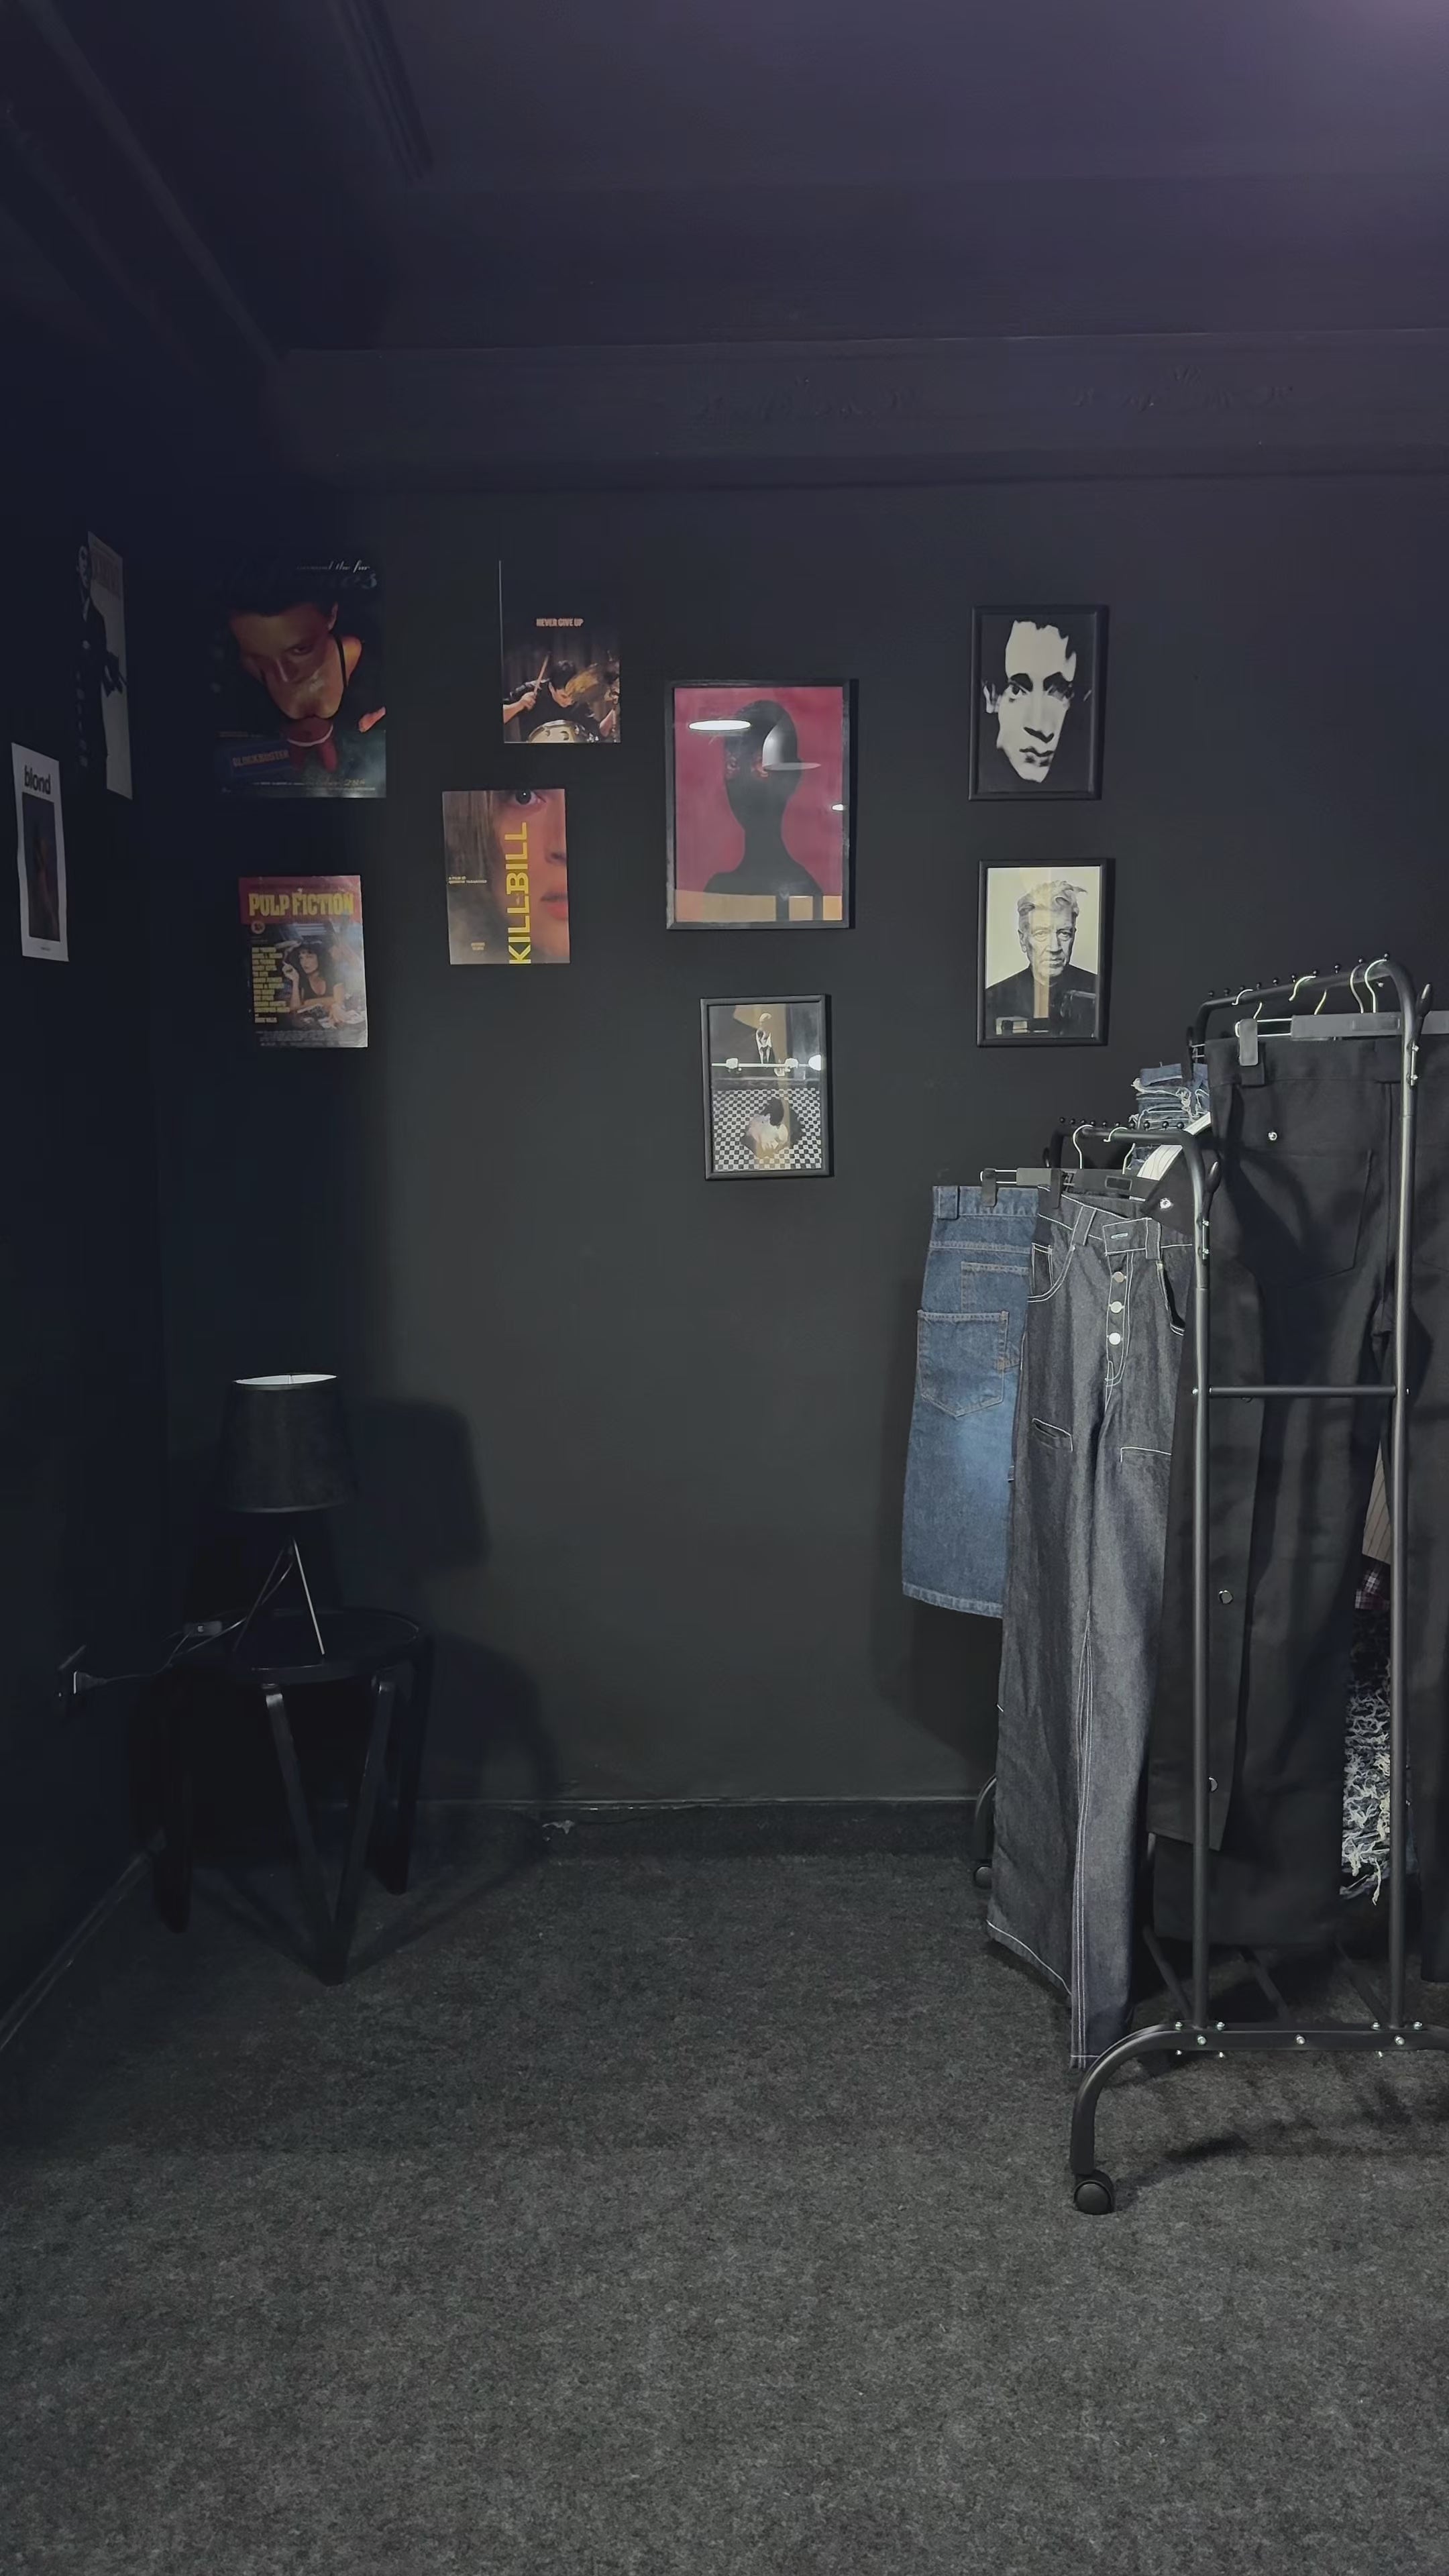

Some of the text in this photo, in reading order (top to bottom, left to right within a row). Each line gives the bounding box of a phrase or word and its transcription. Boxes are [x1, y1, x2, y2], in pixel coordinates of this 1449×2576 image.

[536, 618, 584, 627] NEVER GIVE UP
[24, 765, 51, 794] blond
[248, 892, 354, 916] PULP FICTION
[504, 822, 531, 965] KILL BILL
